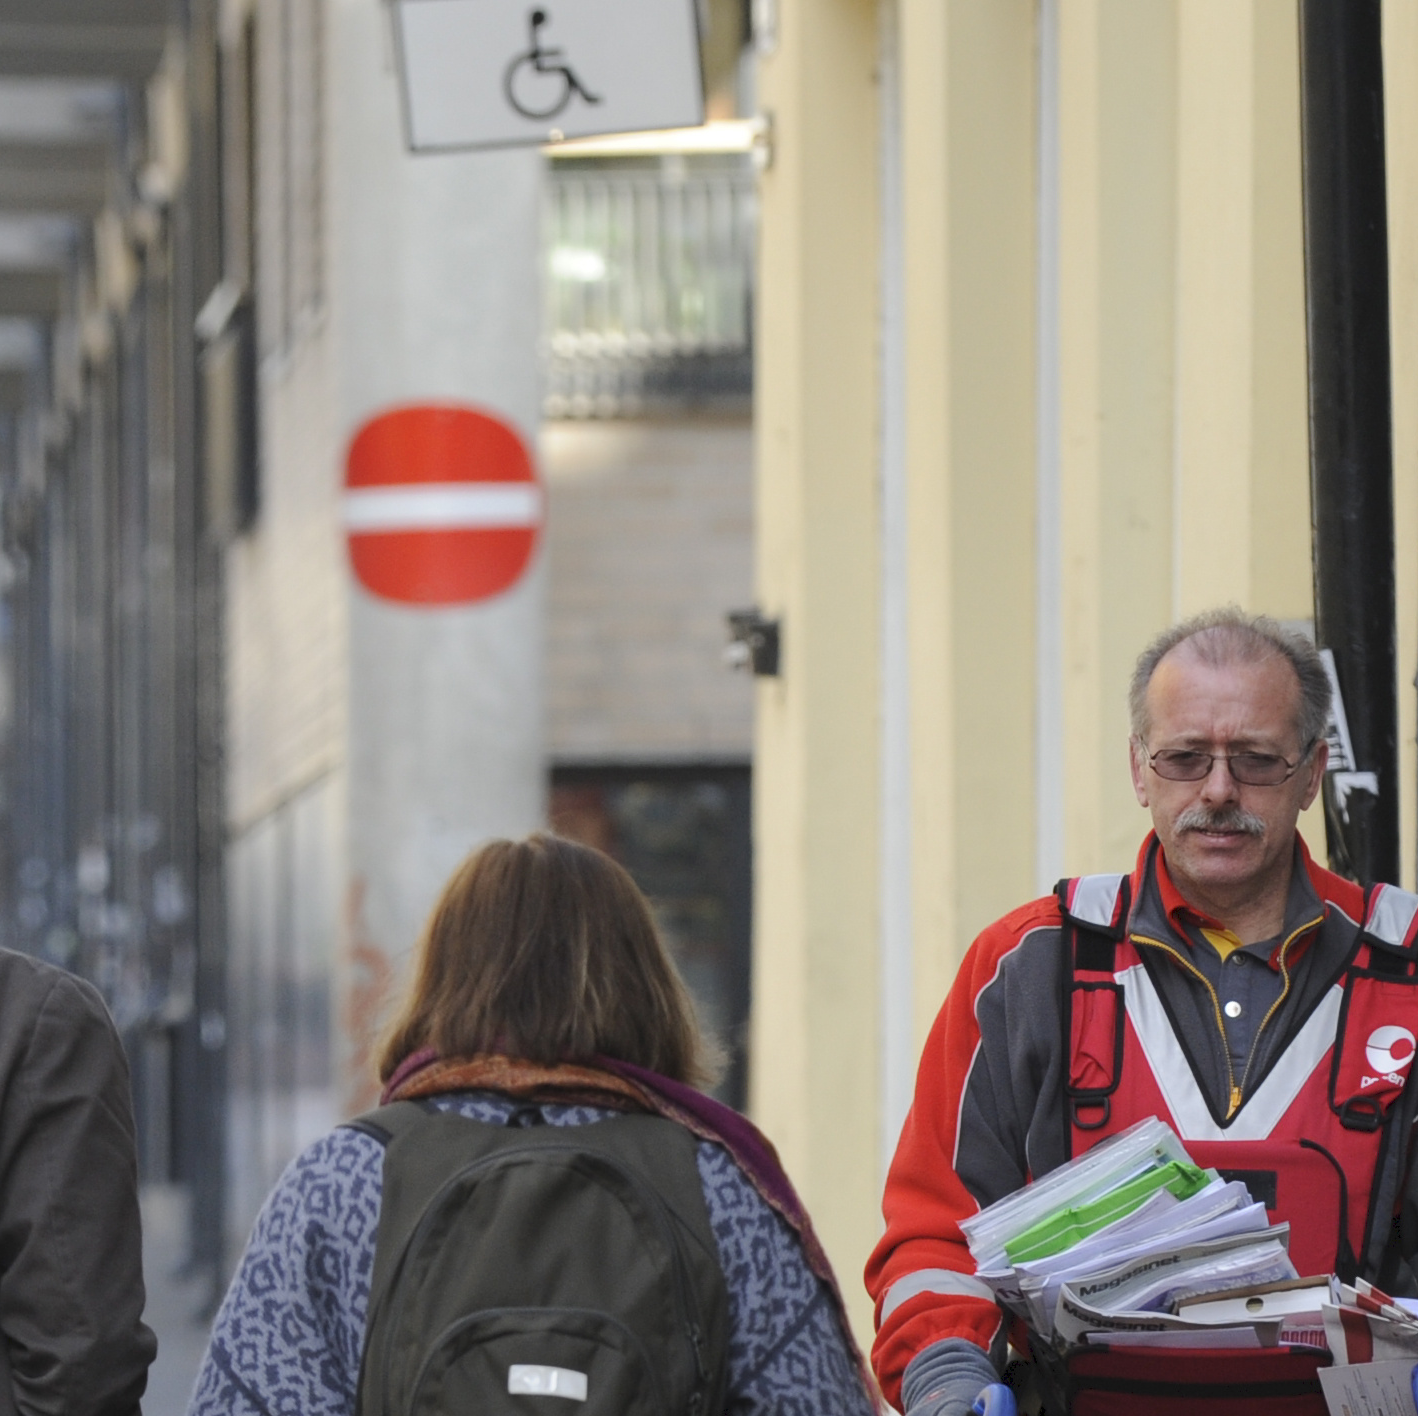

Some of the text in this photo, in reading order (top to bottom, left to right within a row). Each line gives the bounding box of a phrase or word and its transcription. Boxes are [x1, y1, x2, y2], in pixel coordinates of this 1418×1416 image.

[1360, 1073, 1405, 1089] pen
[1079, 1254, 1181, 1297] Magasinet
[1062, 1301, 1167, 1332] Magasinet
